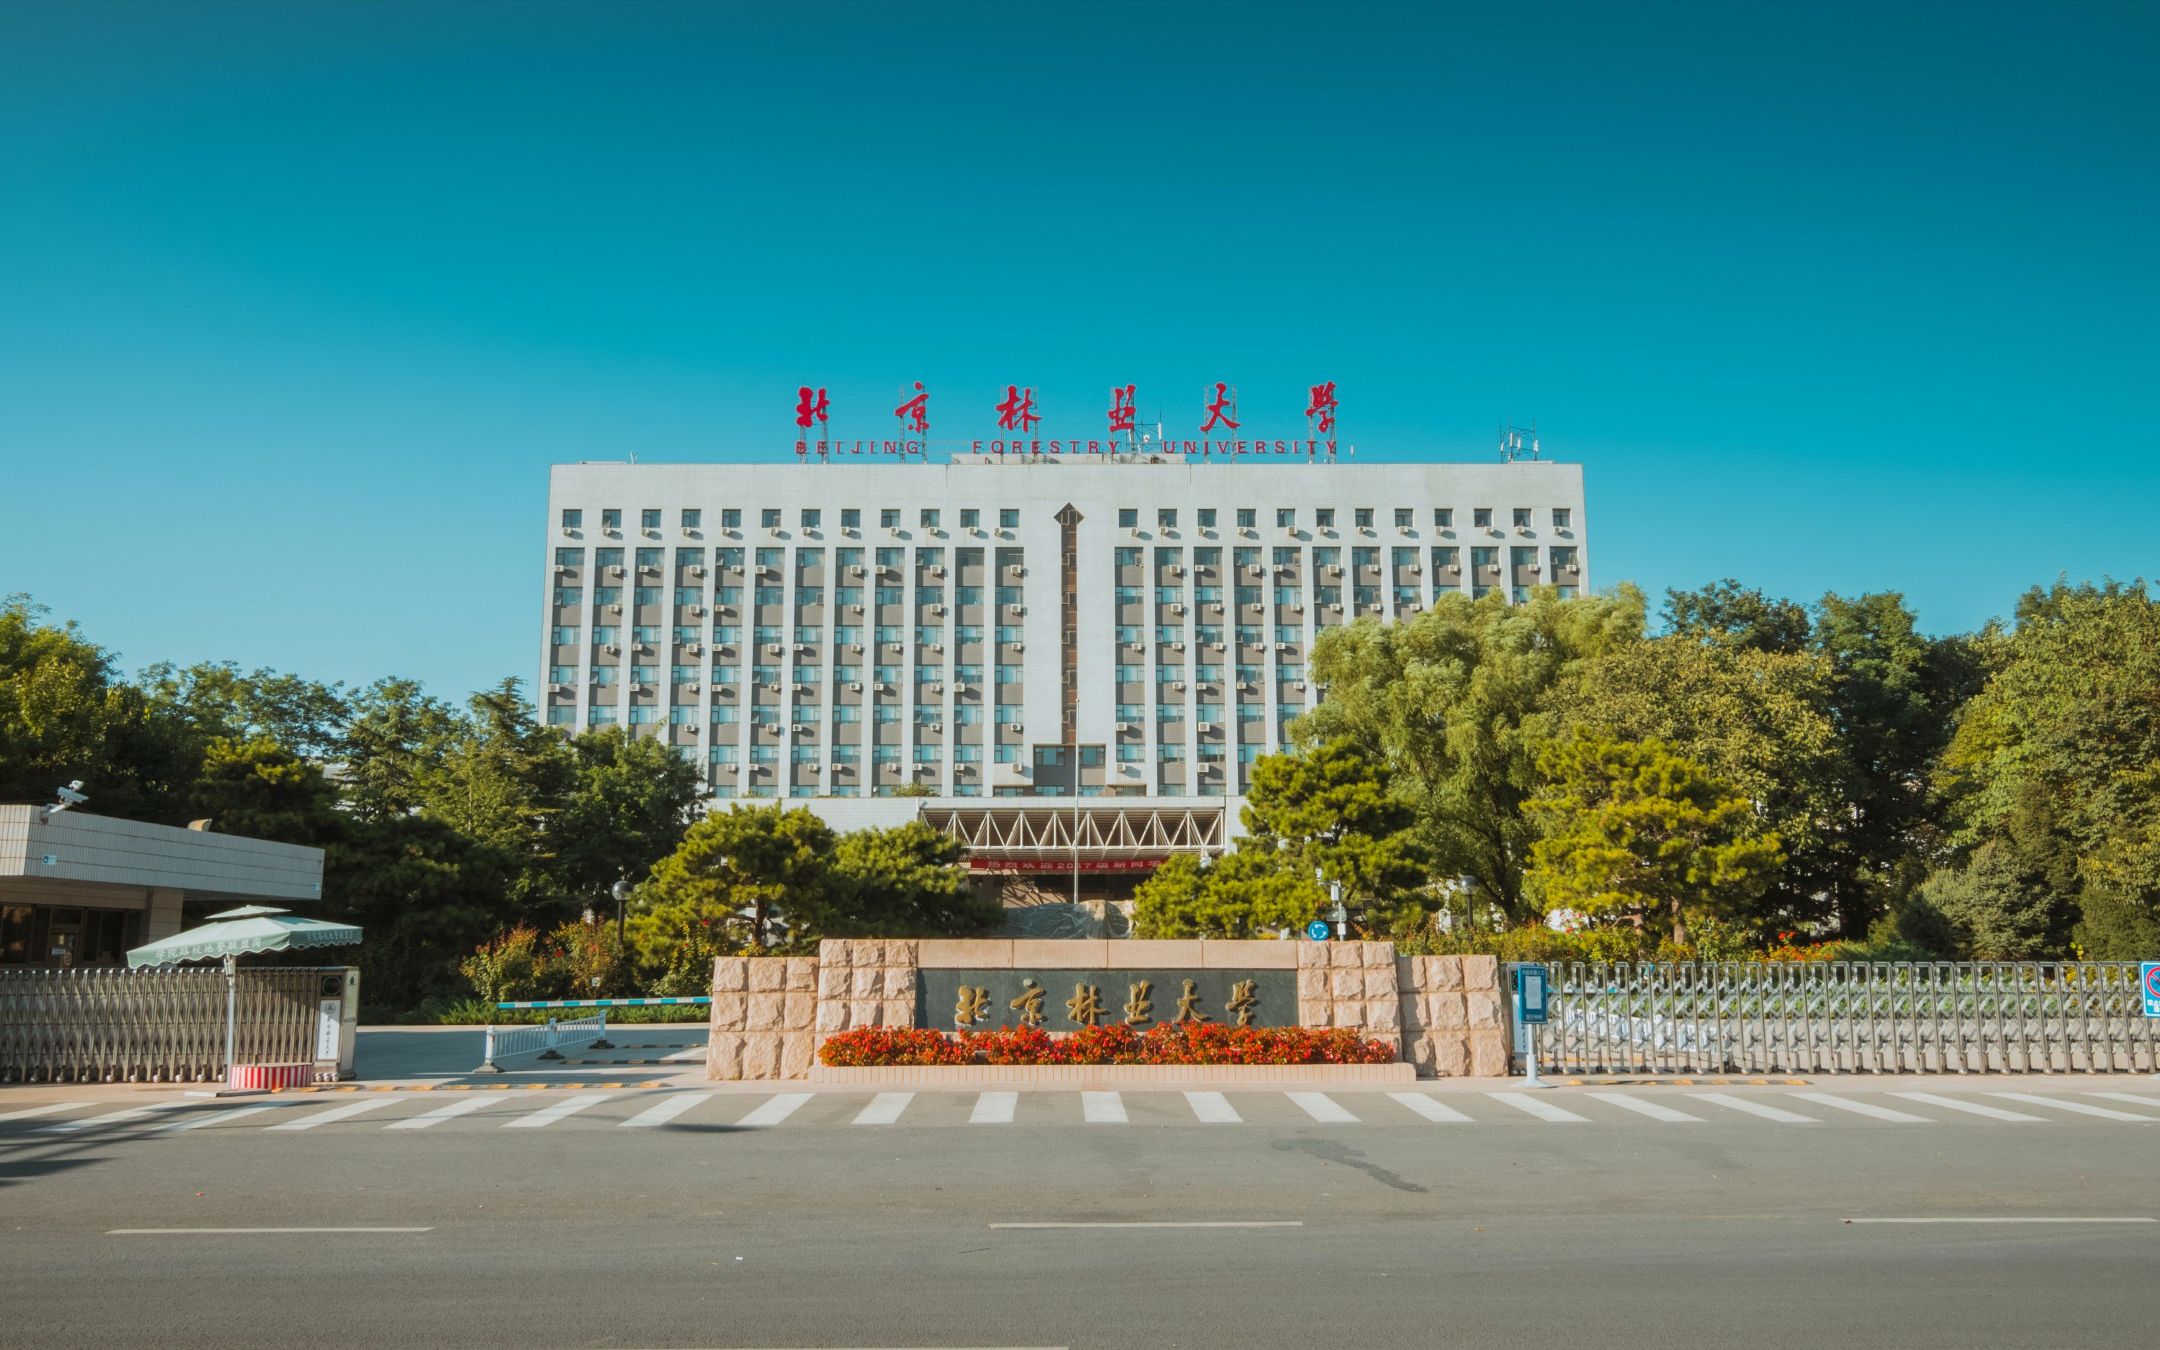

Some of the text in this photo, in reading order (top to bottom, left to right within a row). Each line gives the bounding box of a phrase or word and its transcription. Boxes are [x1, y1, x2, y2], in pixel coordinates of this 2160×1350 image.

[796, 440, 1338, 455] BEIJING FORESTRY UNIVERSITY
